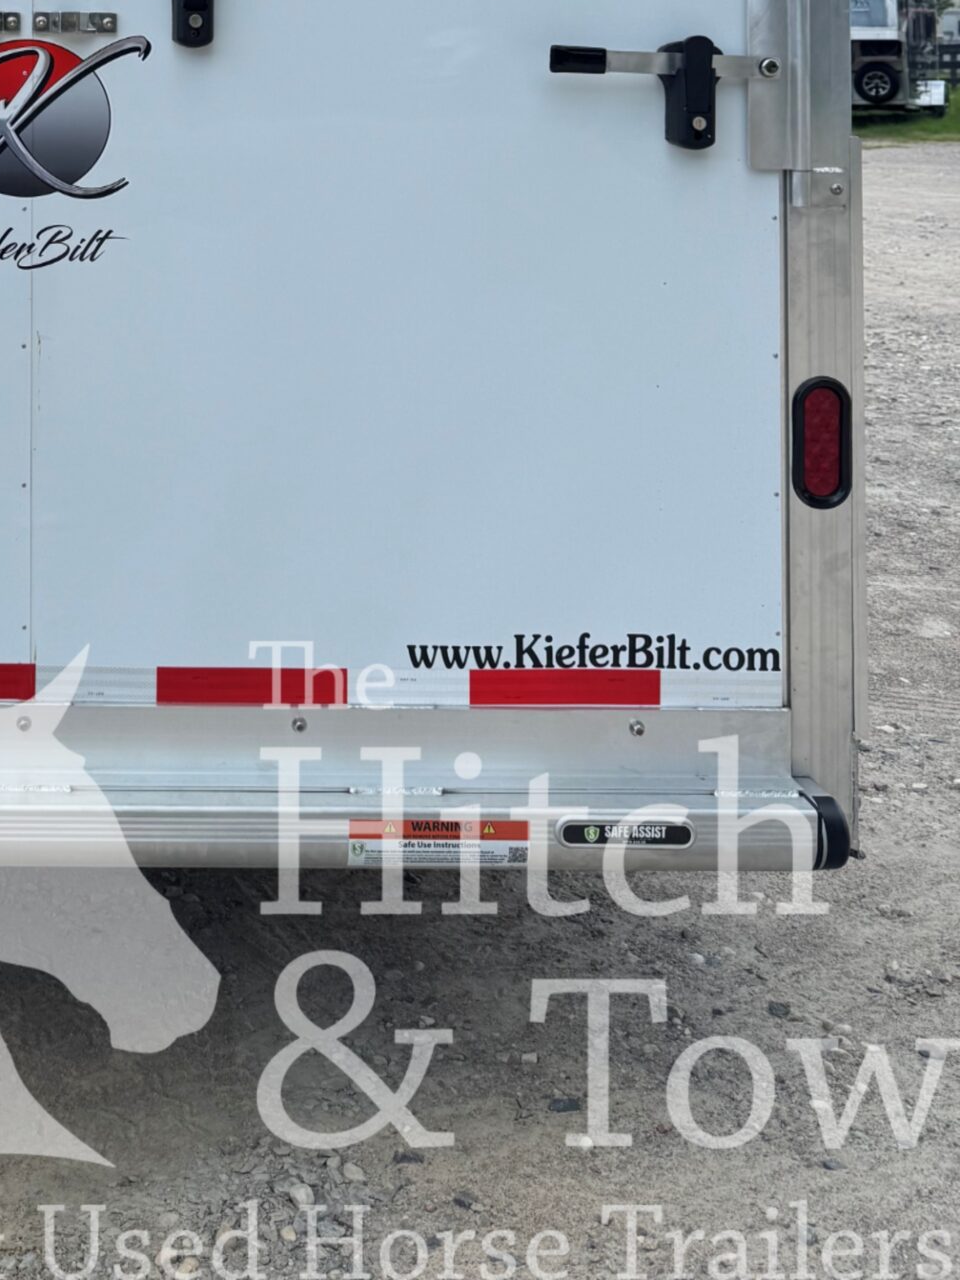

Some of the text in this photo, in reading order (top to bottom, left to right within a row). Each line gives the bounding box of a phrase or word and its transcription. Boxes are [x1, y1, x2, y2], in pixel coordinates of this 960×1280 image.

[407, 632, 782, 672] www.KieferBilt.com
[411, 821, 473, 832] WARNING
[604, 826, 667, 839] SAFE ASSIST
[398, 840, 416, 849] Safe
[417, 840, 432, 849] Use
